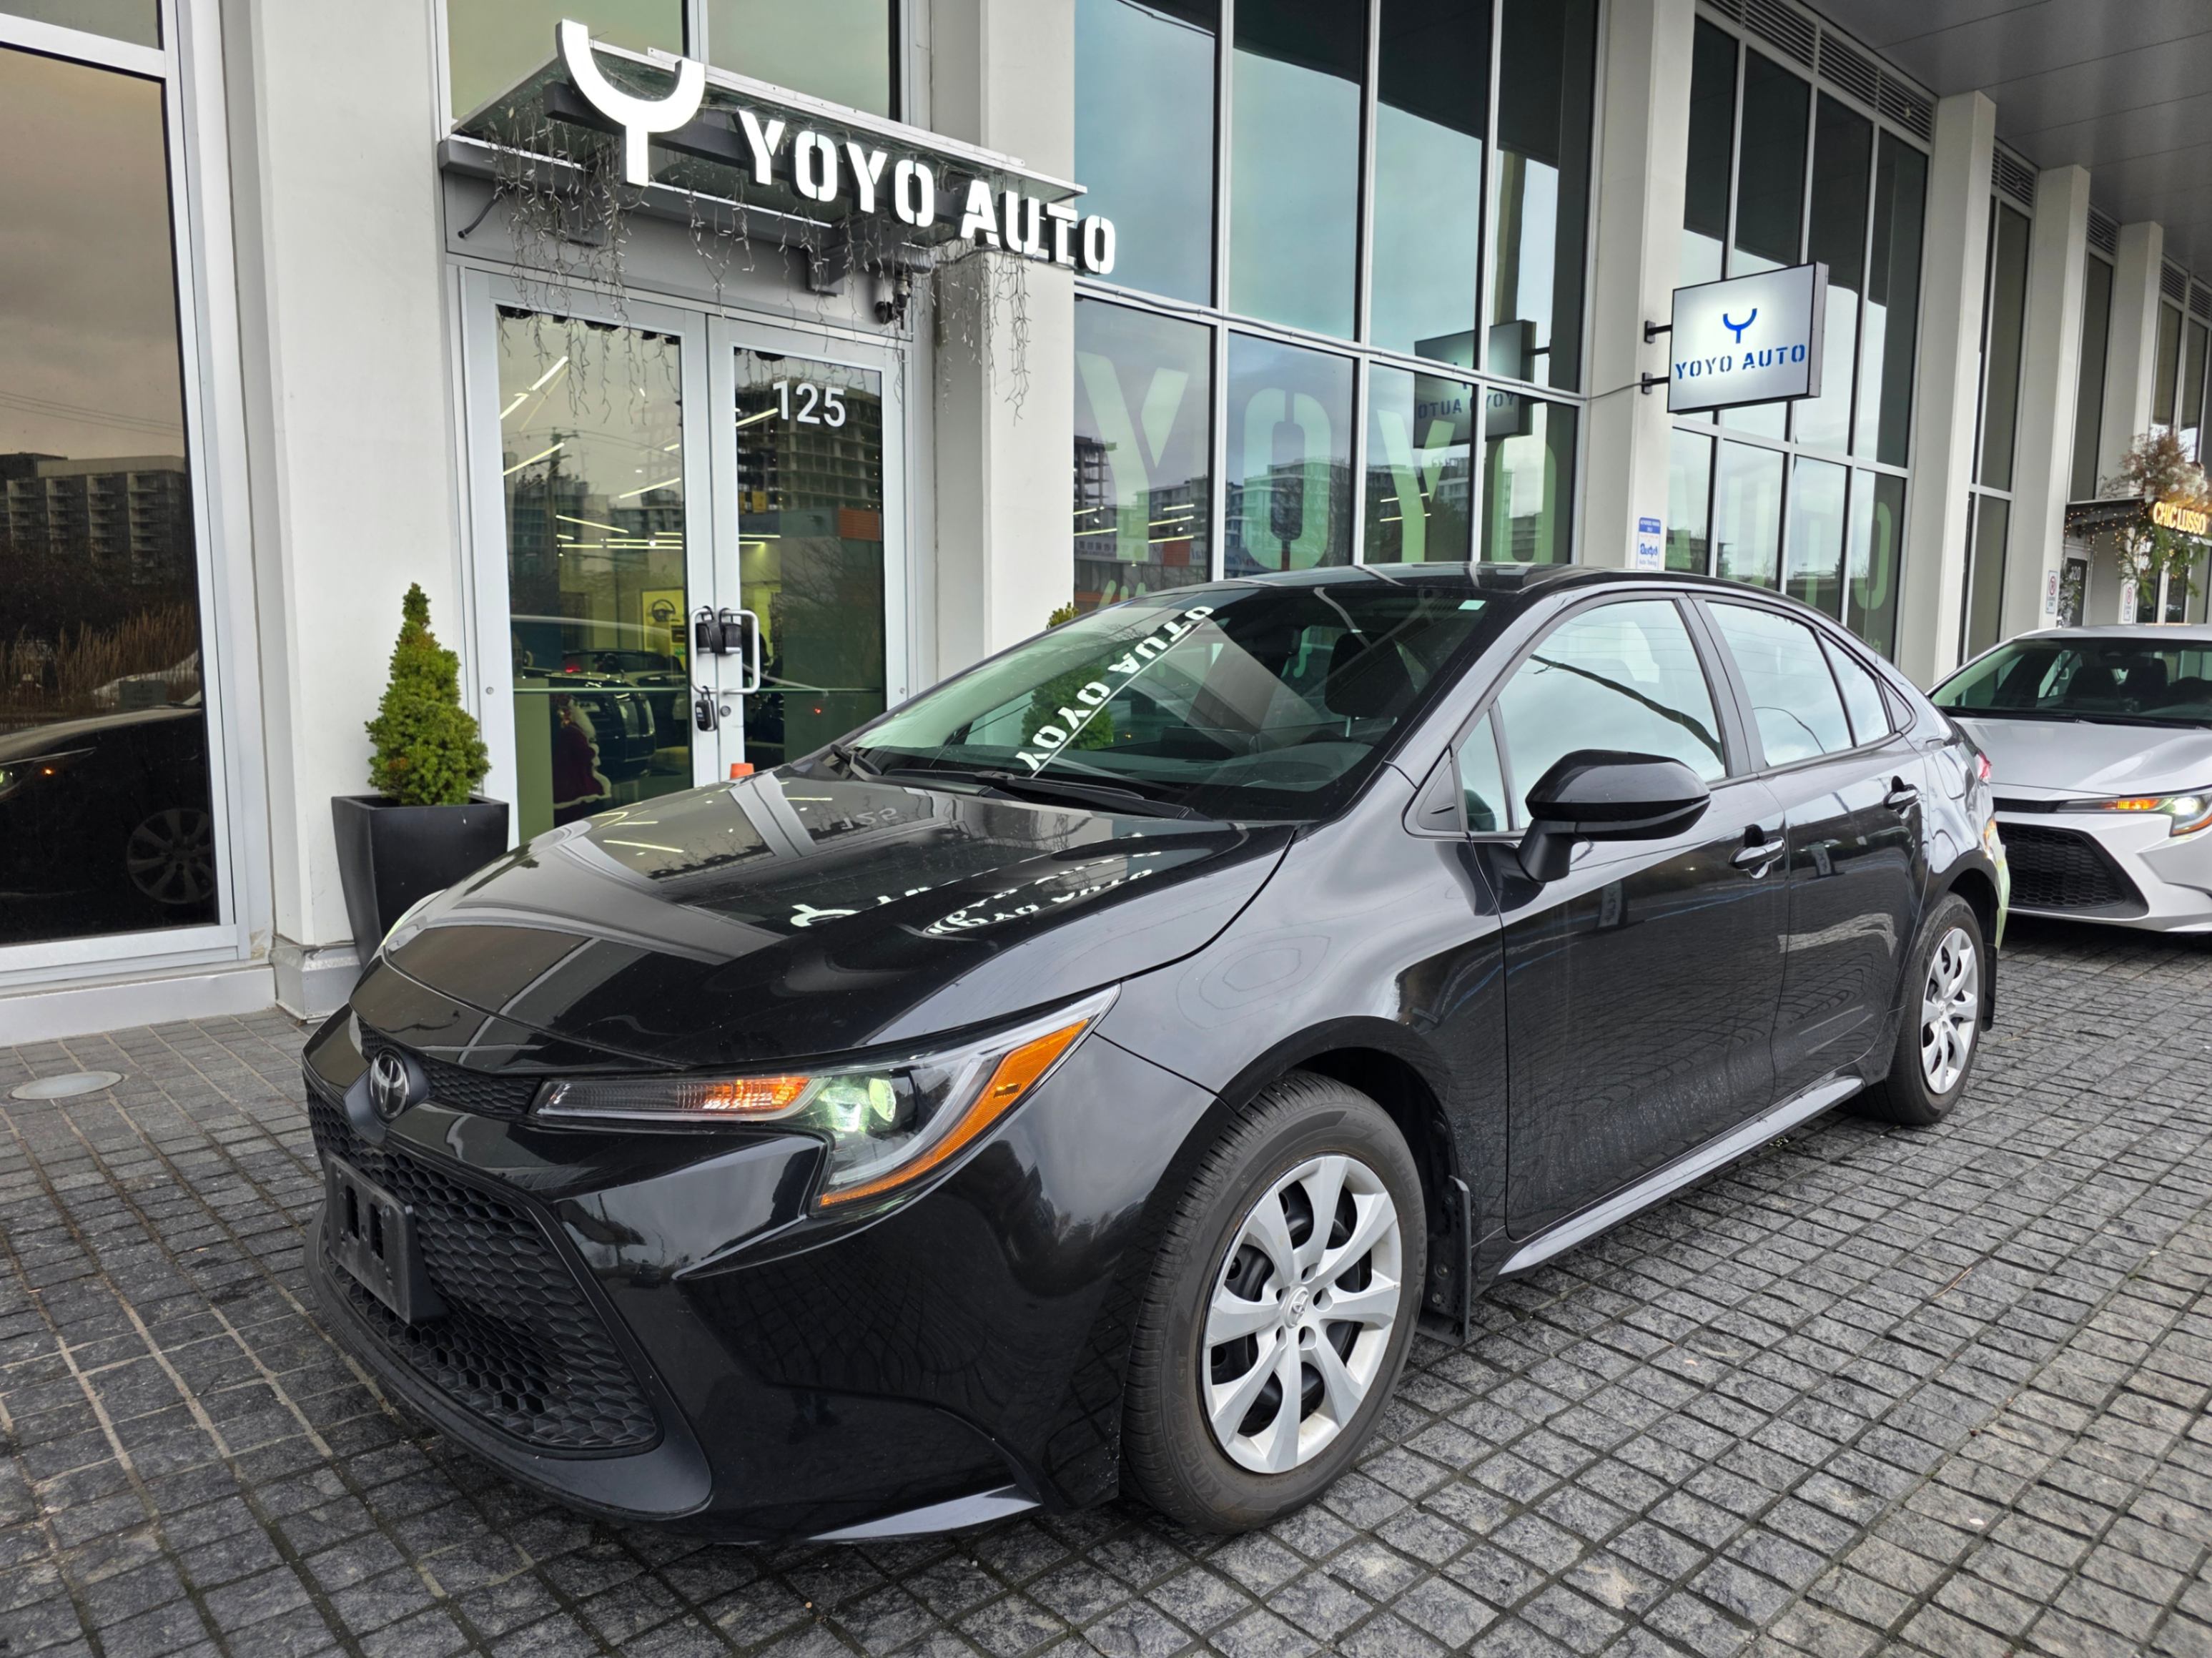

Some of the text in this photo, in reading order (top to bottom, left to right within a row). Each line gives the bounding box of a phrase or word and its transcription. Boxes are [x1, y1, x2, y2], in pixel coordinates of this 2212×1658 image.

[739, 109, 1115, 275] YOYO AUTO
[1675, 344, 1806, 380] YOYO AUTO
[772, 380, 847, 429] 125
[2153, 501, 2207, 535] CHIC LUSSO
